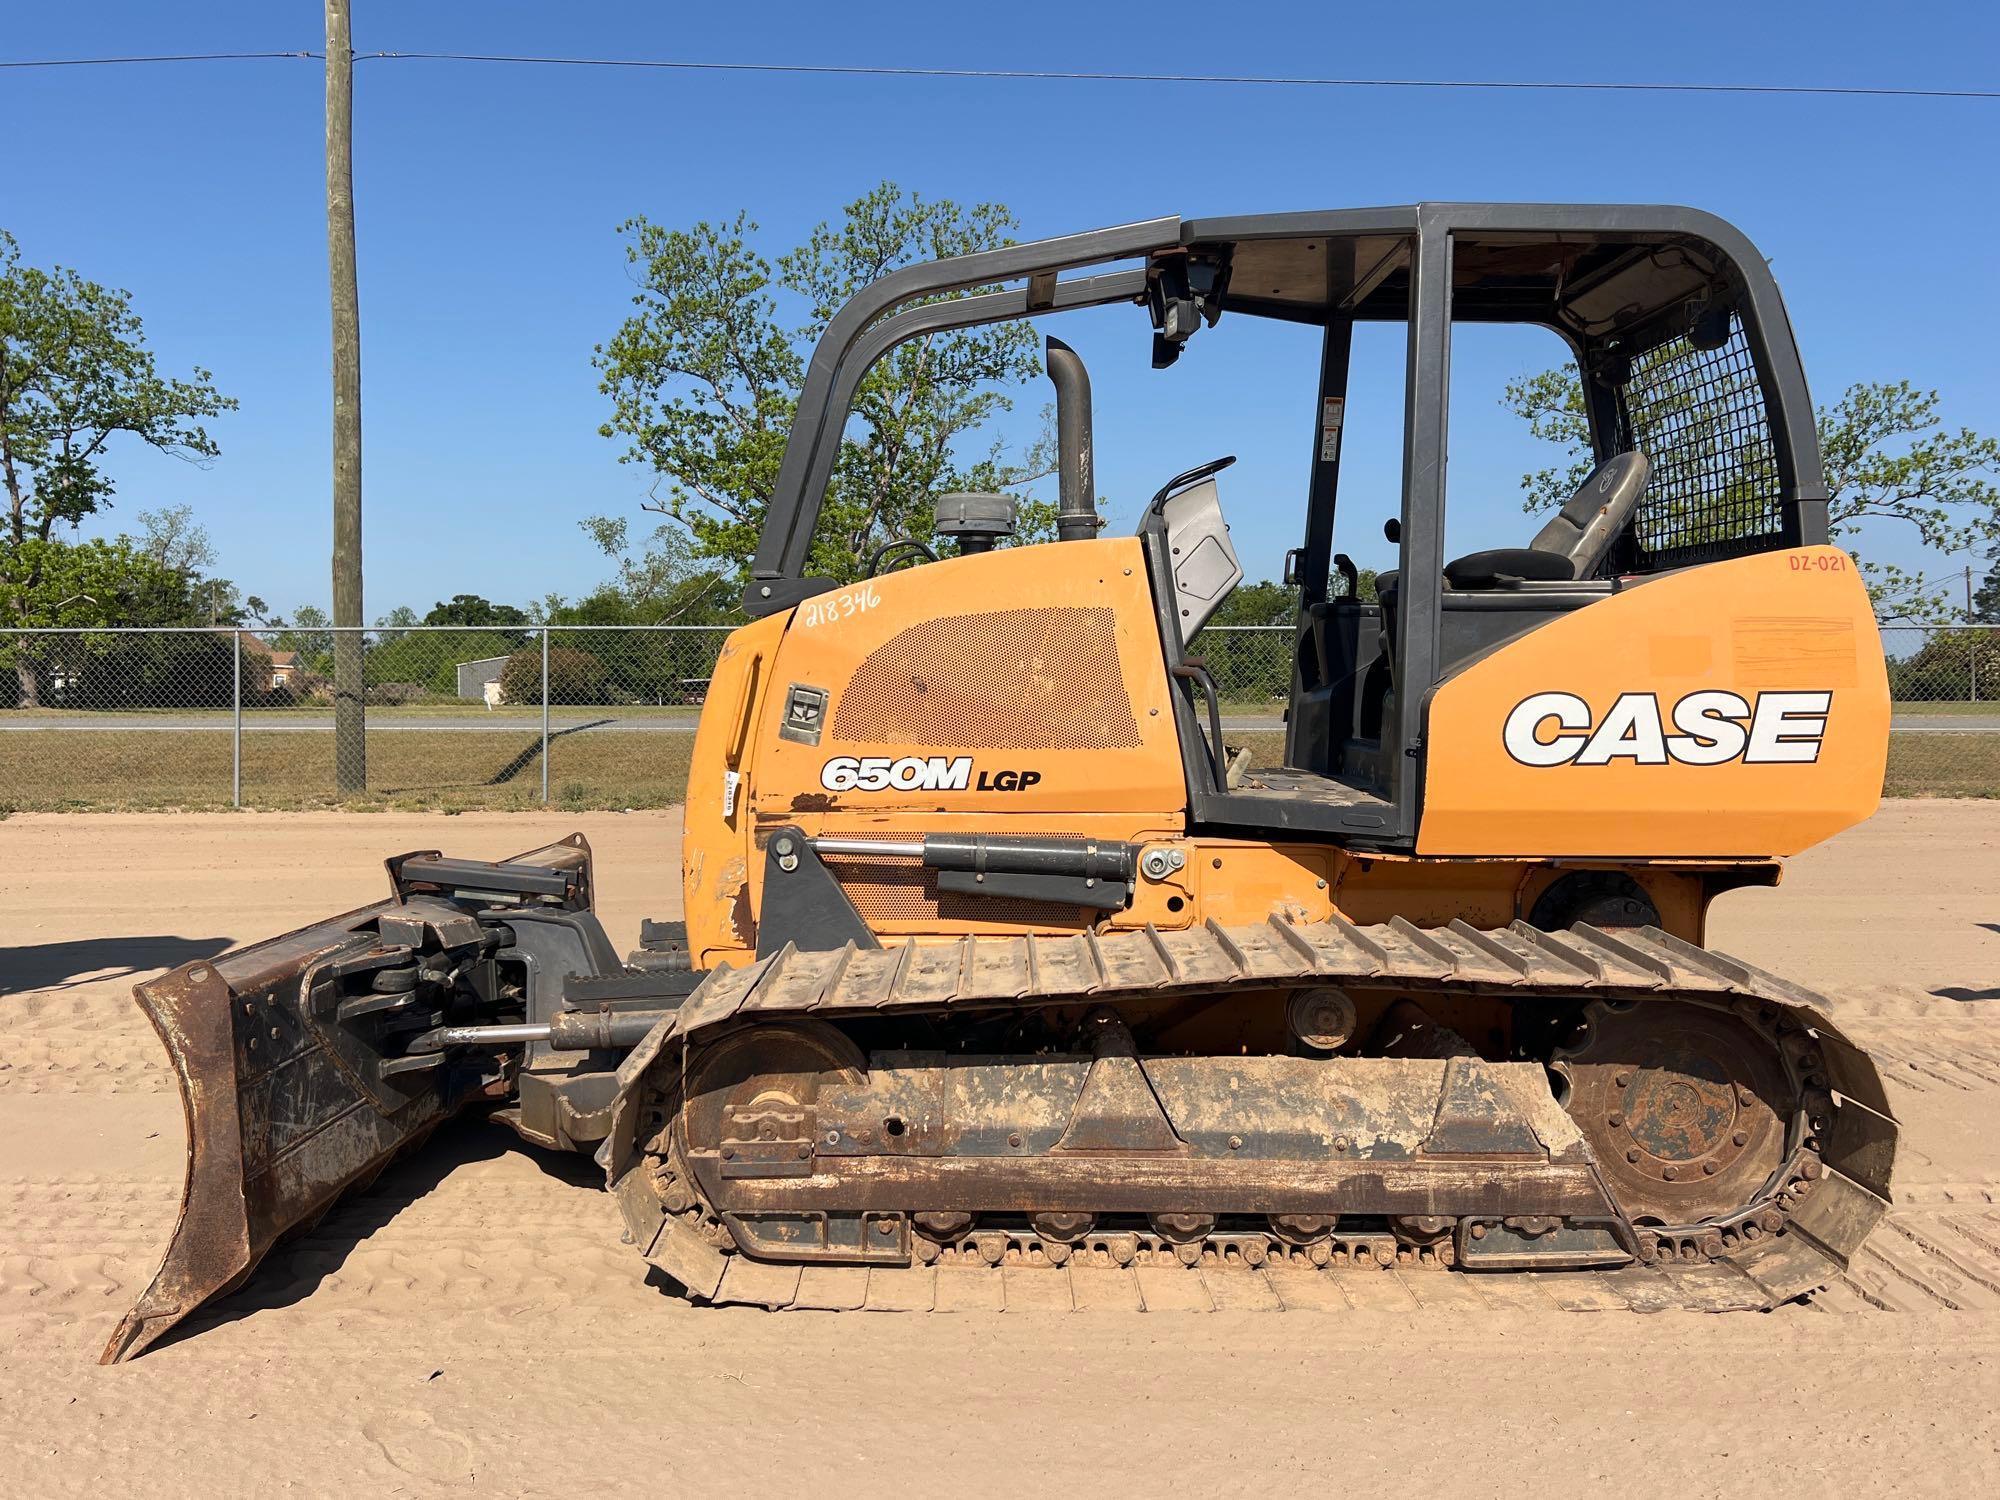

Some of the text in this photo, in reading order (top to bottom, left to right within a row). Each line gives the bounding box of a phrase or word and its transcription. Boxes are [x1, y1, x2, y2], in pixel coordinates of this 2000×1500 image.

[1789, 555, 1846, 572] DZ-021
[806, 584, 881, 628] 218346
[1502, 689, 1834, 768] CASE
[820, 755, 1042, 792] 650M LGP
